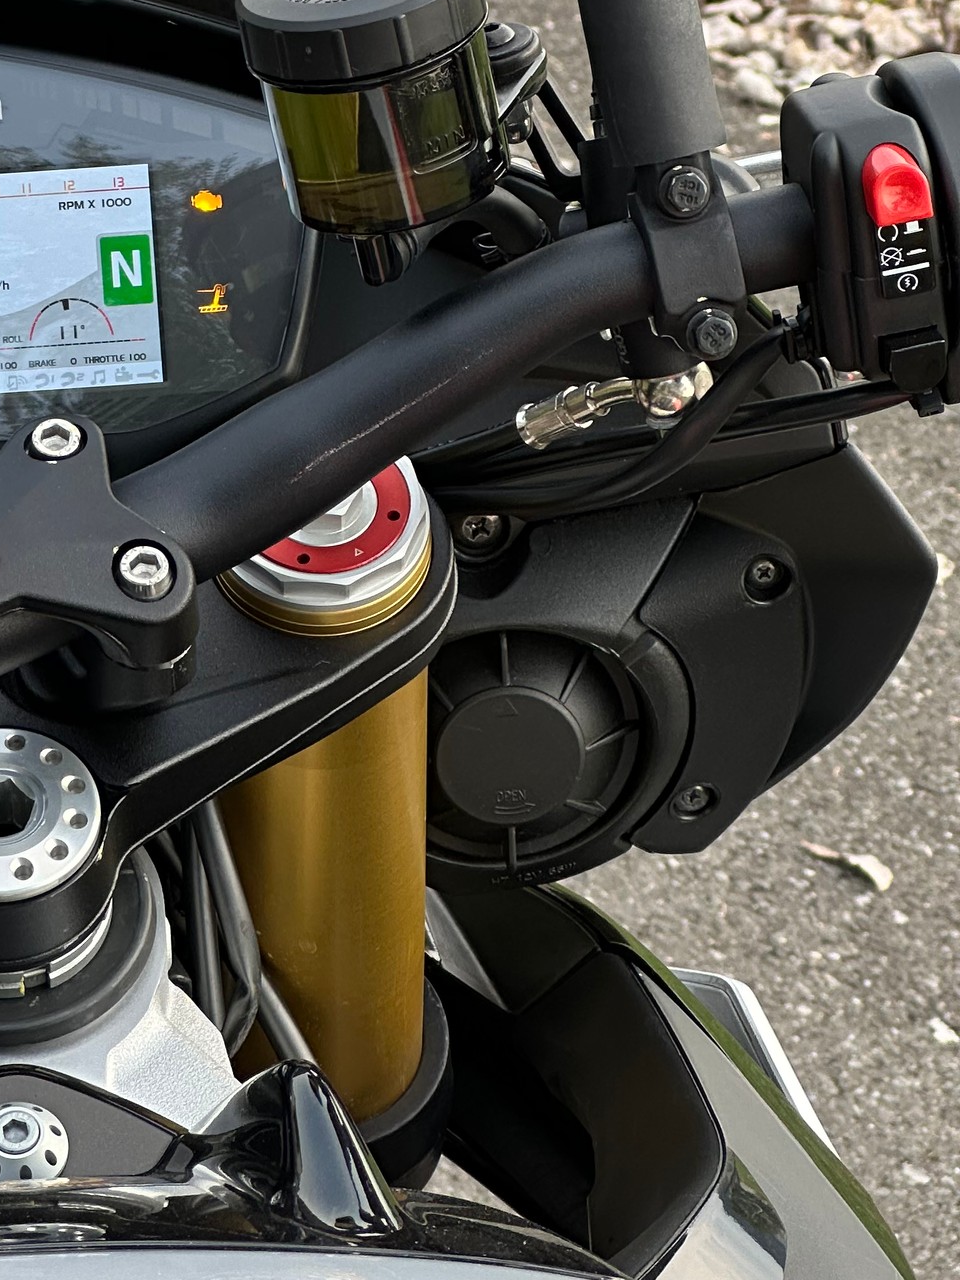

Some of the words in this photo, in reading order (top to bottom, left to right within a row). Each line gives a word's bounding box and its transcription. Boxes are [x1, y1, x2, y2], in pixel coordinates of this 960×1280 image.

[21, 183, 32, 194] 11
[63, 180, 75, 191] 12
[113, 176, 125, 188] 13
[58, 199, 84, 211] RPM
[88, 199, 96, 209] X
[101, 197, 132, 208] 1000
[110, 250, 143, 288] N
[2, 335, 23, 344] ROLL
[0, 361, 18, 370] 100
[29, 358, 57, 368] BRAKE
[70, 357, 78, 366] 0
[84, 354, 126, 364] THROTTLE
[129, 352, 147, 362] 100
[497, 788, 527, 803] OPEN
